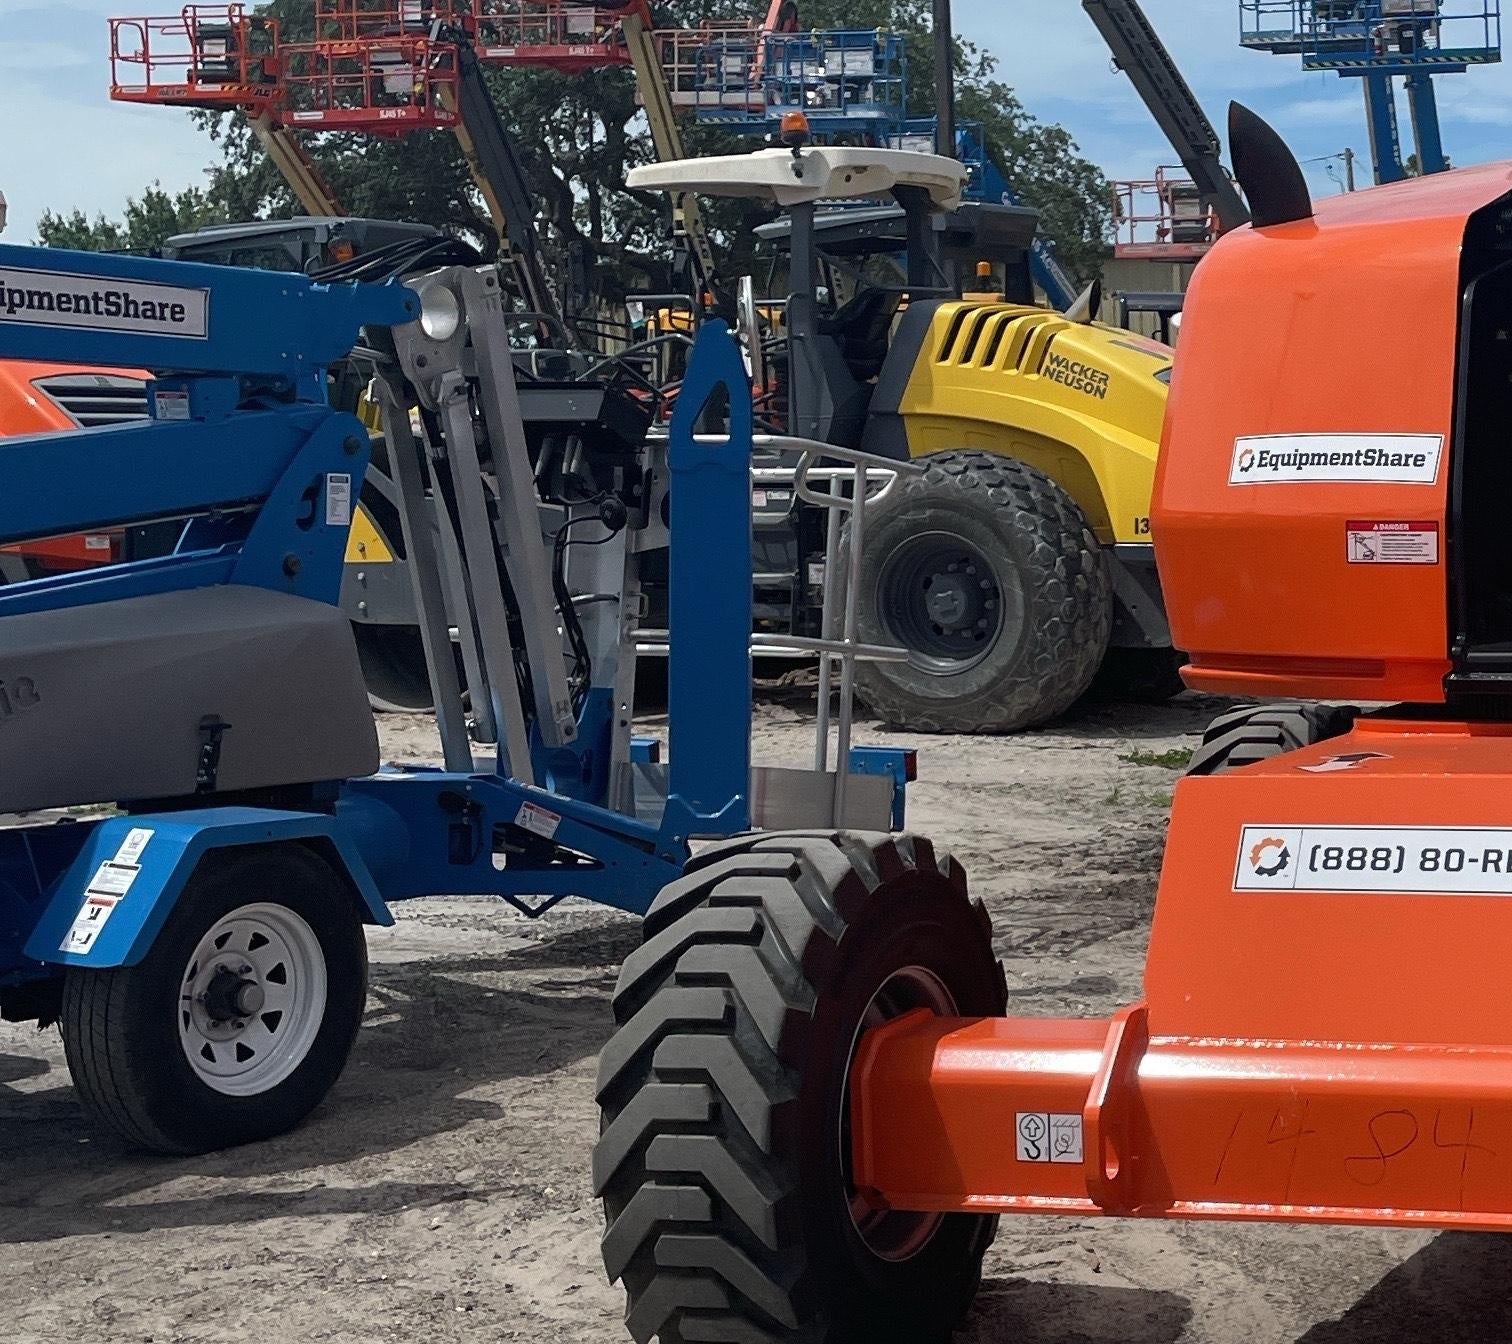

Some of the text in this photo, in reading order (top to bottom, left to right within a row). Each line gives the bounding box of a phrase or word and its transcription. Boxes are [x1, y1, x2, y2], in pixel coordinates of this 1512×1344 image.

[1042, 366, 1108, 400] NEUSON
[1049, 351, 1110, 386] WACKER
[1257, 449, 1426, 471] EquipmentShare
[1309, 844, 1405, 873] (888)
